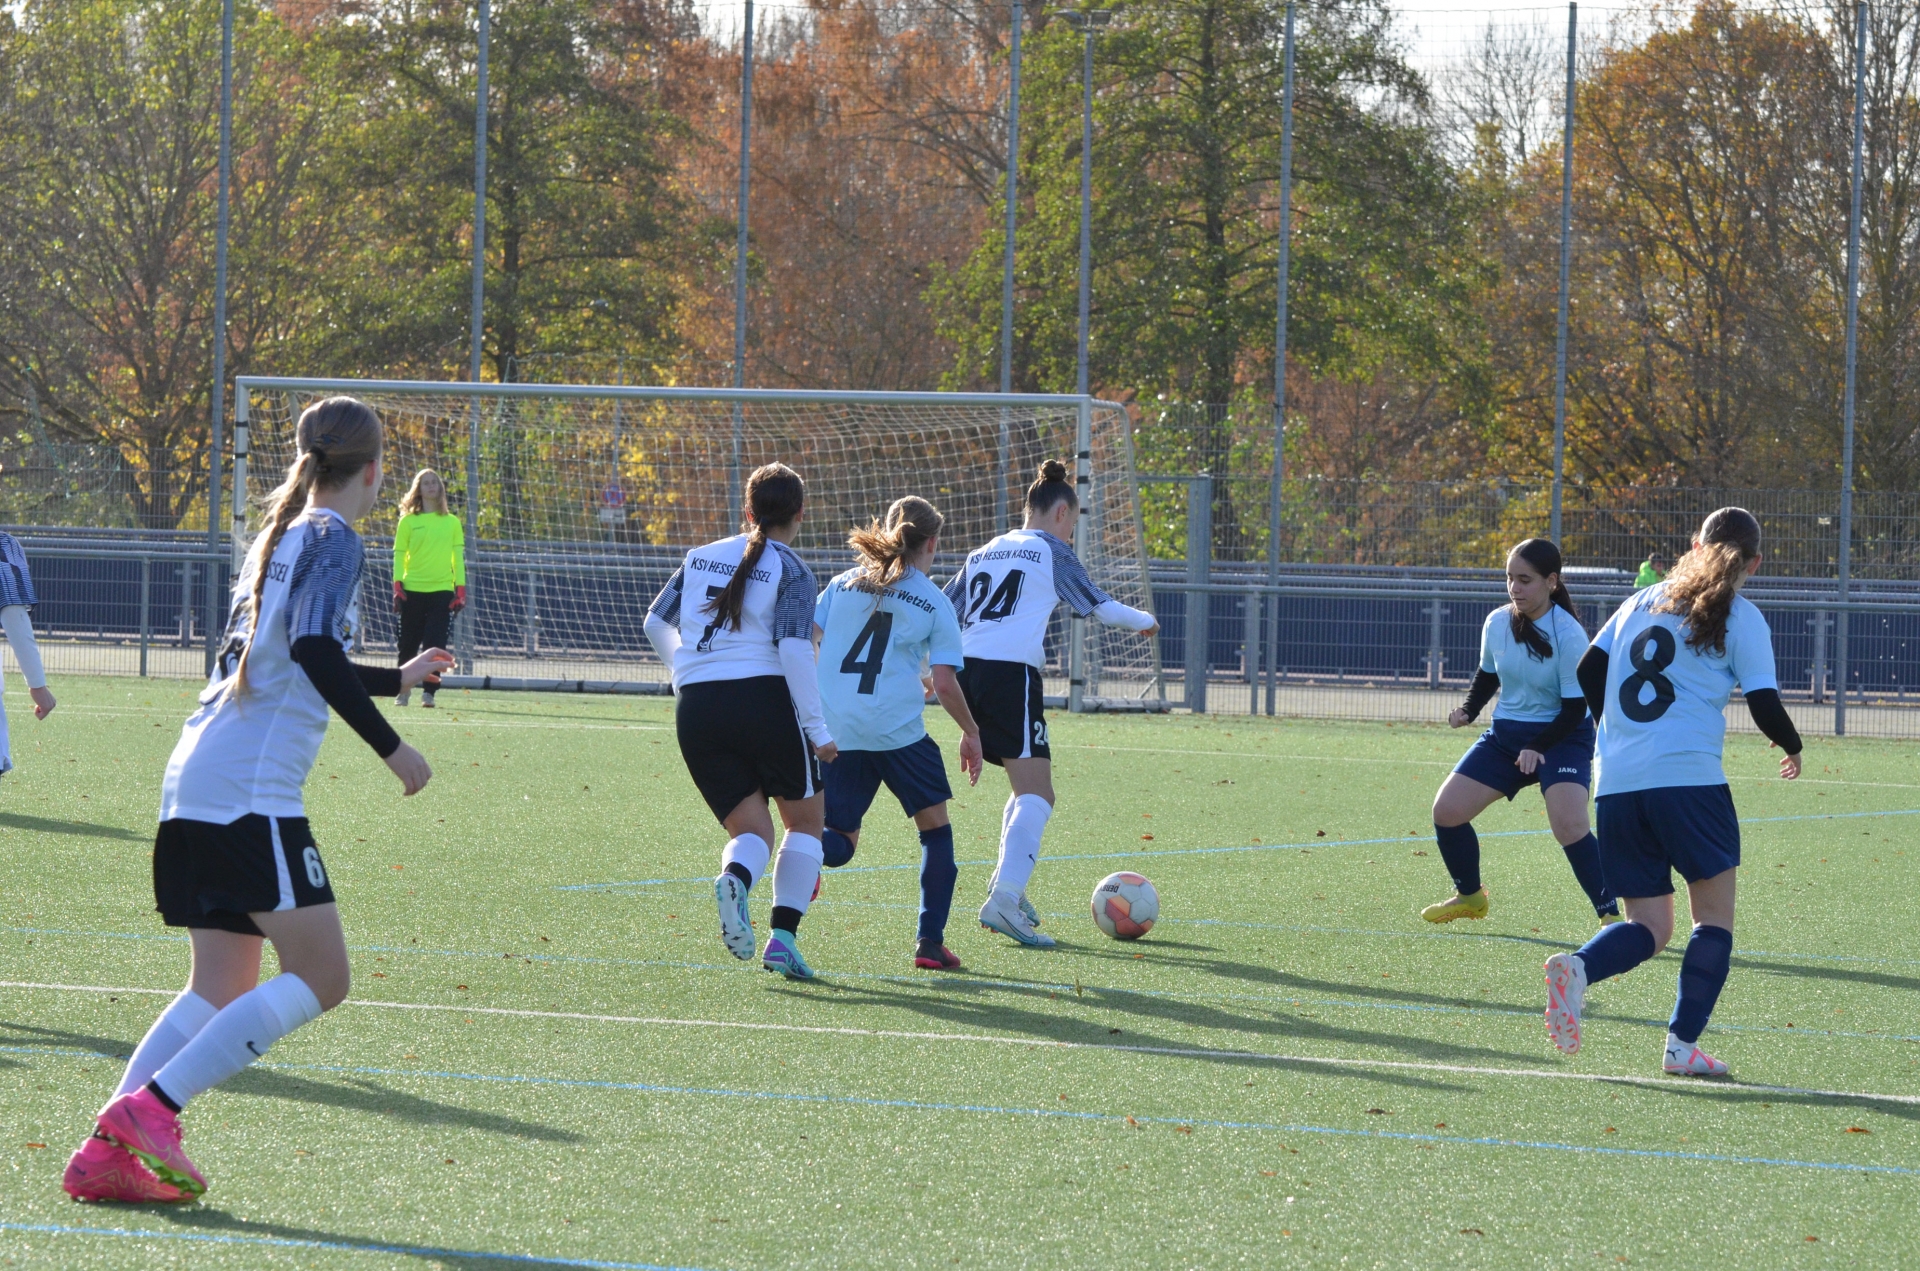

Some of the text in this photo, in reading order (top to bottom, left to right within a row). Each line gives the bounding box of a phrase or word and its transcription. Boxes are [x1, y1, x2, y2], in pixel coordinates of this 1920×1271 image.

[691, 557, 771, 583] KSV HESSE ASSEL
[983, 550, 1012, 561] HESSEN
[1011, 549, 1041, 563] KASSEL
[897, 590, 936, 614] Wetzlar
[963, 569, 1026, 631] 24
[840, 611, 893, 695] 4
[1619, 625, 1676, 723] 8
[303, 846, 325, 888] 6
[1597, 900, 1615, 910] JAKO
